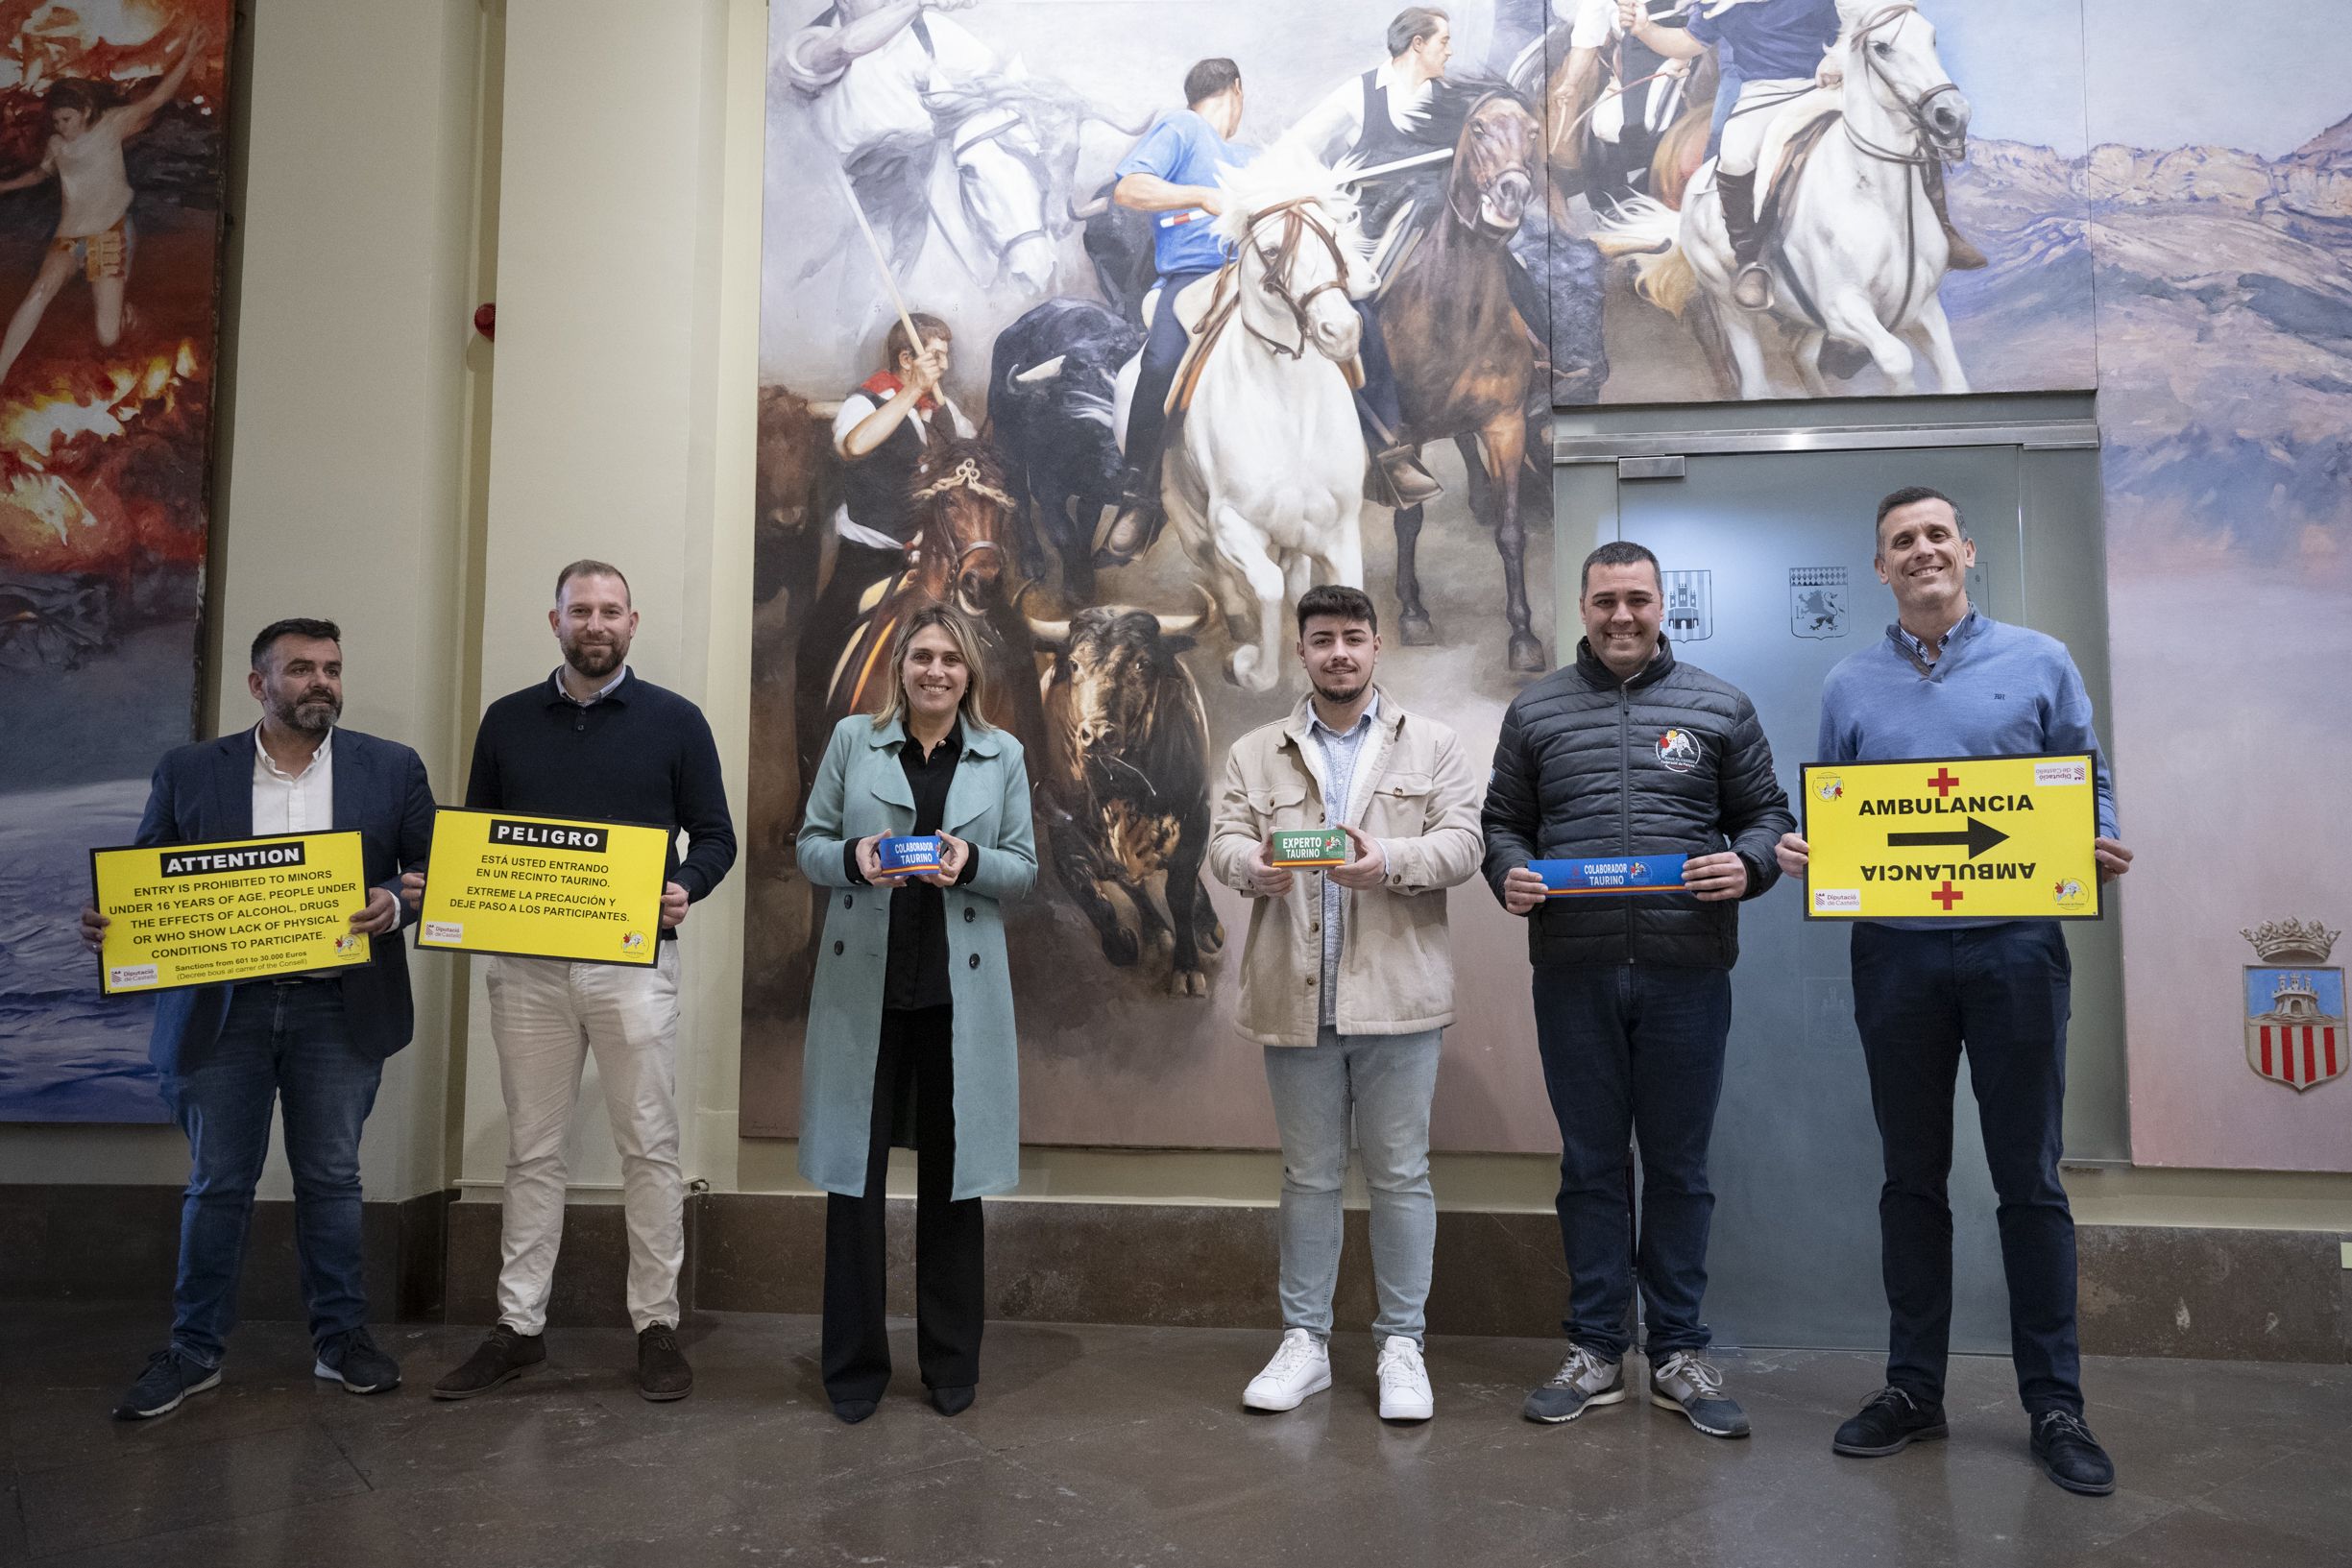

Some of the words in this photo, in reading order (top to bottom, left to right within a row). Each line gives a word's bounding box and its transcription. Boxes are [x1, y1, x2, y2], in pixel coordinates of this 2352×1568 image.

[1858, 794, 2034, 816] AMBULANCIA
[497, 826, 598, 847] PELIGRO
[1283, 837, 1321, 849] EXPERTO
[895, 841, 934, 854] COLABORADOR
[1285, 849, 1320, 858] TAURINO
[167, 848, 299, 873] ATTENTION
[481, 855, 508, 865] ESTÁ
[511, 857, 546, 868] USTED
[549, 860, 609, 874] ENTRANDO
[901, 853, 933, 864] TAURINO
[476, 868, 491, 878] EN
[494, 869, 508, 879] UN
[511, 871, 557, 883] RECINTO
[560, 875, 610, 888] TAURINO.
[1585, 863, 1627, 875] COLABORADOR
[1859, 862, 2037, 881] AMBULANCIA
[133, 884, 175, 897] ENTRY
[179, 883, 190, 893] IS
[193, 877, 266, 892] PROHIBITED
[269, 875, 284, 883] TO
[288, 870, 332, 882] MINORS
[1588, 876, 1624, 886] TAURINO
[109, 903, 153, 915] UNDER
[157, 902, 170, 910] 16
[173, 897, 215, 909] YEARS
[218, 895, 234, 905] OF
[237, 892, 266, 903] AGE,
[269, 886, 314, 900] PEOPLE
[317, 882, 356, 894] UNDER
[467, 886, 516, 899] EXTREME
[519, 890, 532, 900] LA
[535, 892, 606, 905] PRECAUCIÓN
[609, 898, 617, 906] Y
[130, 918, 156, 929] THE
[158, 912, 214, 927] EFFECTS
[217, 910, 234, 921] OF
[237, 905, 297, 918] ALCOHOL,
[300, 899, 340, 911] DRUGS
[449, 899, 476, 909] DEJE
[478, 901, 507, 911] PASO
[509, 904, 517, 912] A
[519, 905, 541, 914] LOS
[544, 906, 630, 922] PARTICIPANTES.
[133, 934, 152, 945] OR
[155, 931, 185, 943] WHO
[189, 927, 226, 939] SHOW
[230, 923, 261, 935] LACK
[264, 921, 280, 930] OF
[283, 915, 340, 929] PHYSICAL
[151, 942, 228, 959] CONDITIONS
[230, 940, 247, 950] TO
[250, 930, 326, 948] PARTICIPATE.
[175, 962, 214, 972] Sanctions
[260, 953, 284, 962] 30.000
